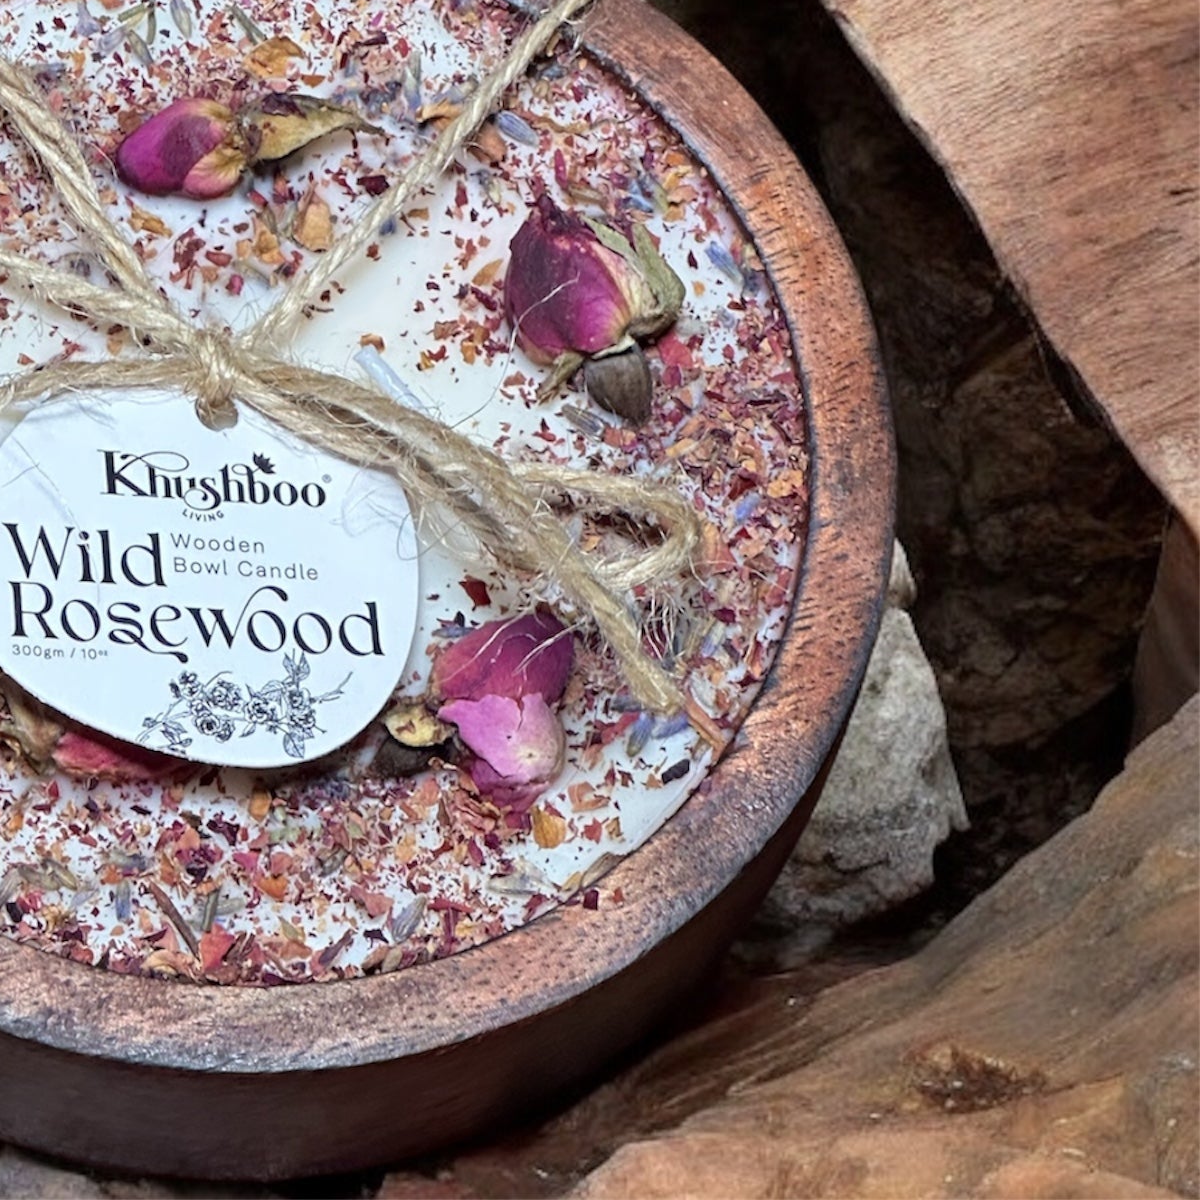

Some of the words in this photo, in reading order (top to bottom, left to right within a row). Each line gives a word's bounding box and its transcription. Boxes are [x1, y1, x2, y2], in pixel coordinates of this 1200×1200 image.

[182, 509, 225, 522] LIVING
[2, 522, 168, 588] Wild
[170, 531, 266, 555] Wooden
[173, 555, 229, 577] Bowl
[237, 559, 320, 582] Candle
[8, 580, 386, 663] Rosewood
[11, 643, 65, 660] 300gm
